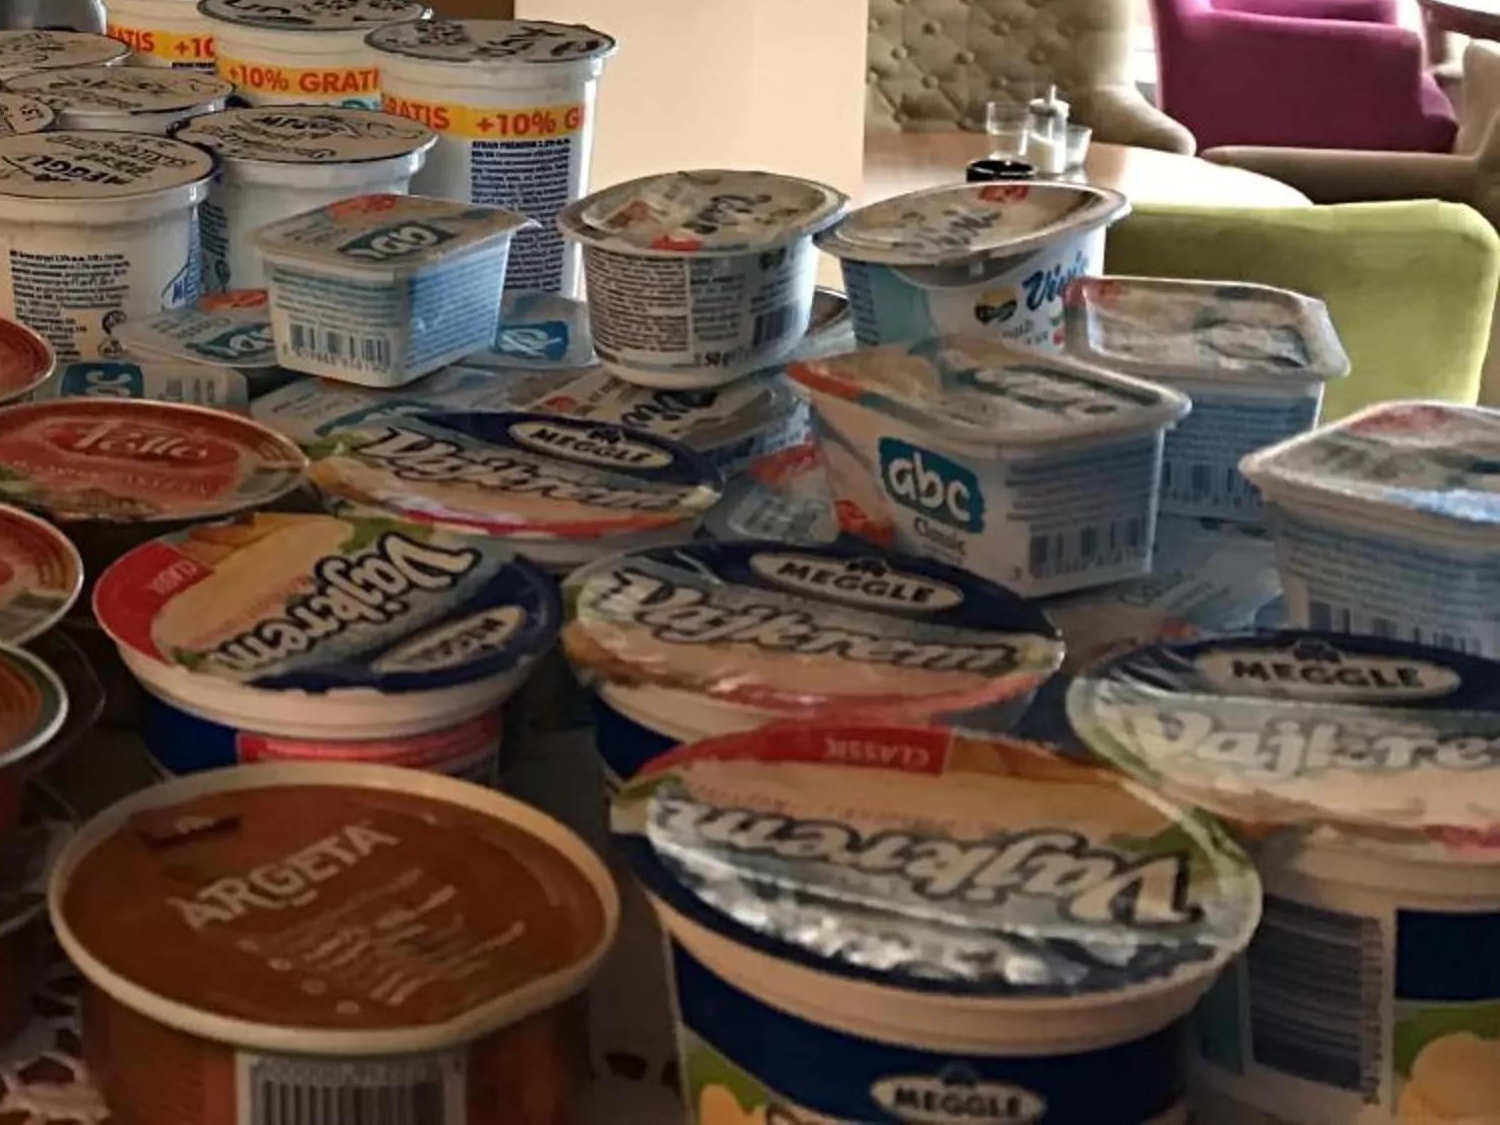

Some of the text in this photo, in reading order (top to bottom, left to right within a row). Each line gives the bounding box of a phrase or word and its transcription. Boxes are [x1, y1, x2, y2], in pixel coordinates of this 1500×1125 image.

[229, 64, 289, 91] +10%
[299, 67, 380, 94] GRATI
[475, 111, 557, 136] +10%
[528, 427, 654, 463] MEGGLE
[887, 452, 972, 522] abc
[207, 530, 483, 672] Vajkrem
[778, 560, 935, 605] MEGGLE
[1232, 658, 1424, 689] MEGGLE
[1105, 707, 1500, 778] Vajkre
[165, 823, 402, 930] ARGETA
[656, 795, 1204, 924] Vajkrem
[891, 1086, 1023, 1118] MEGGLE
